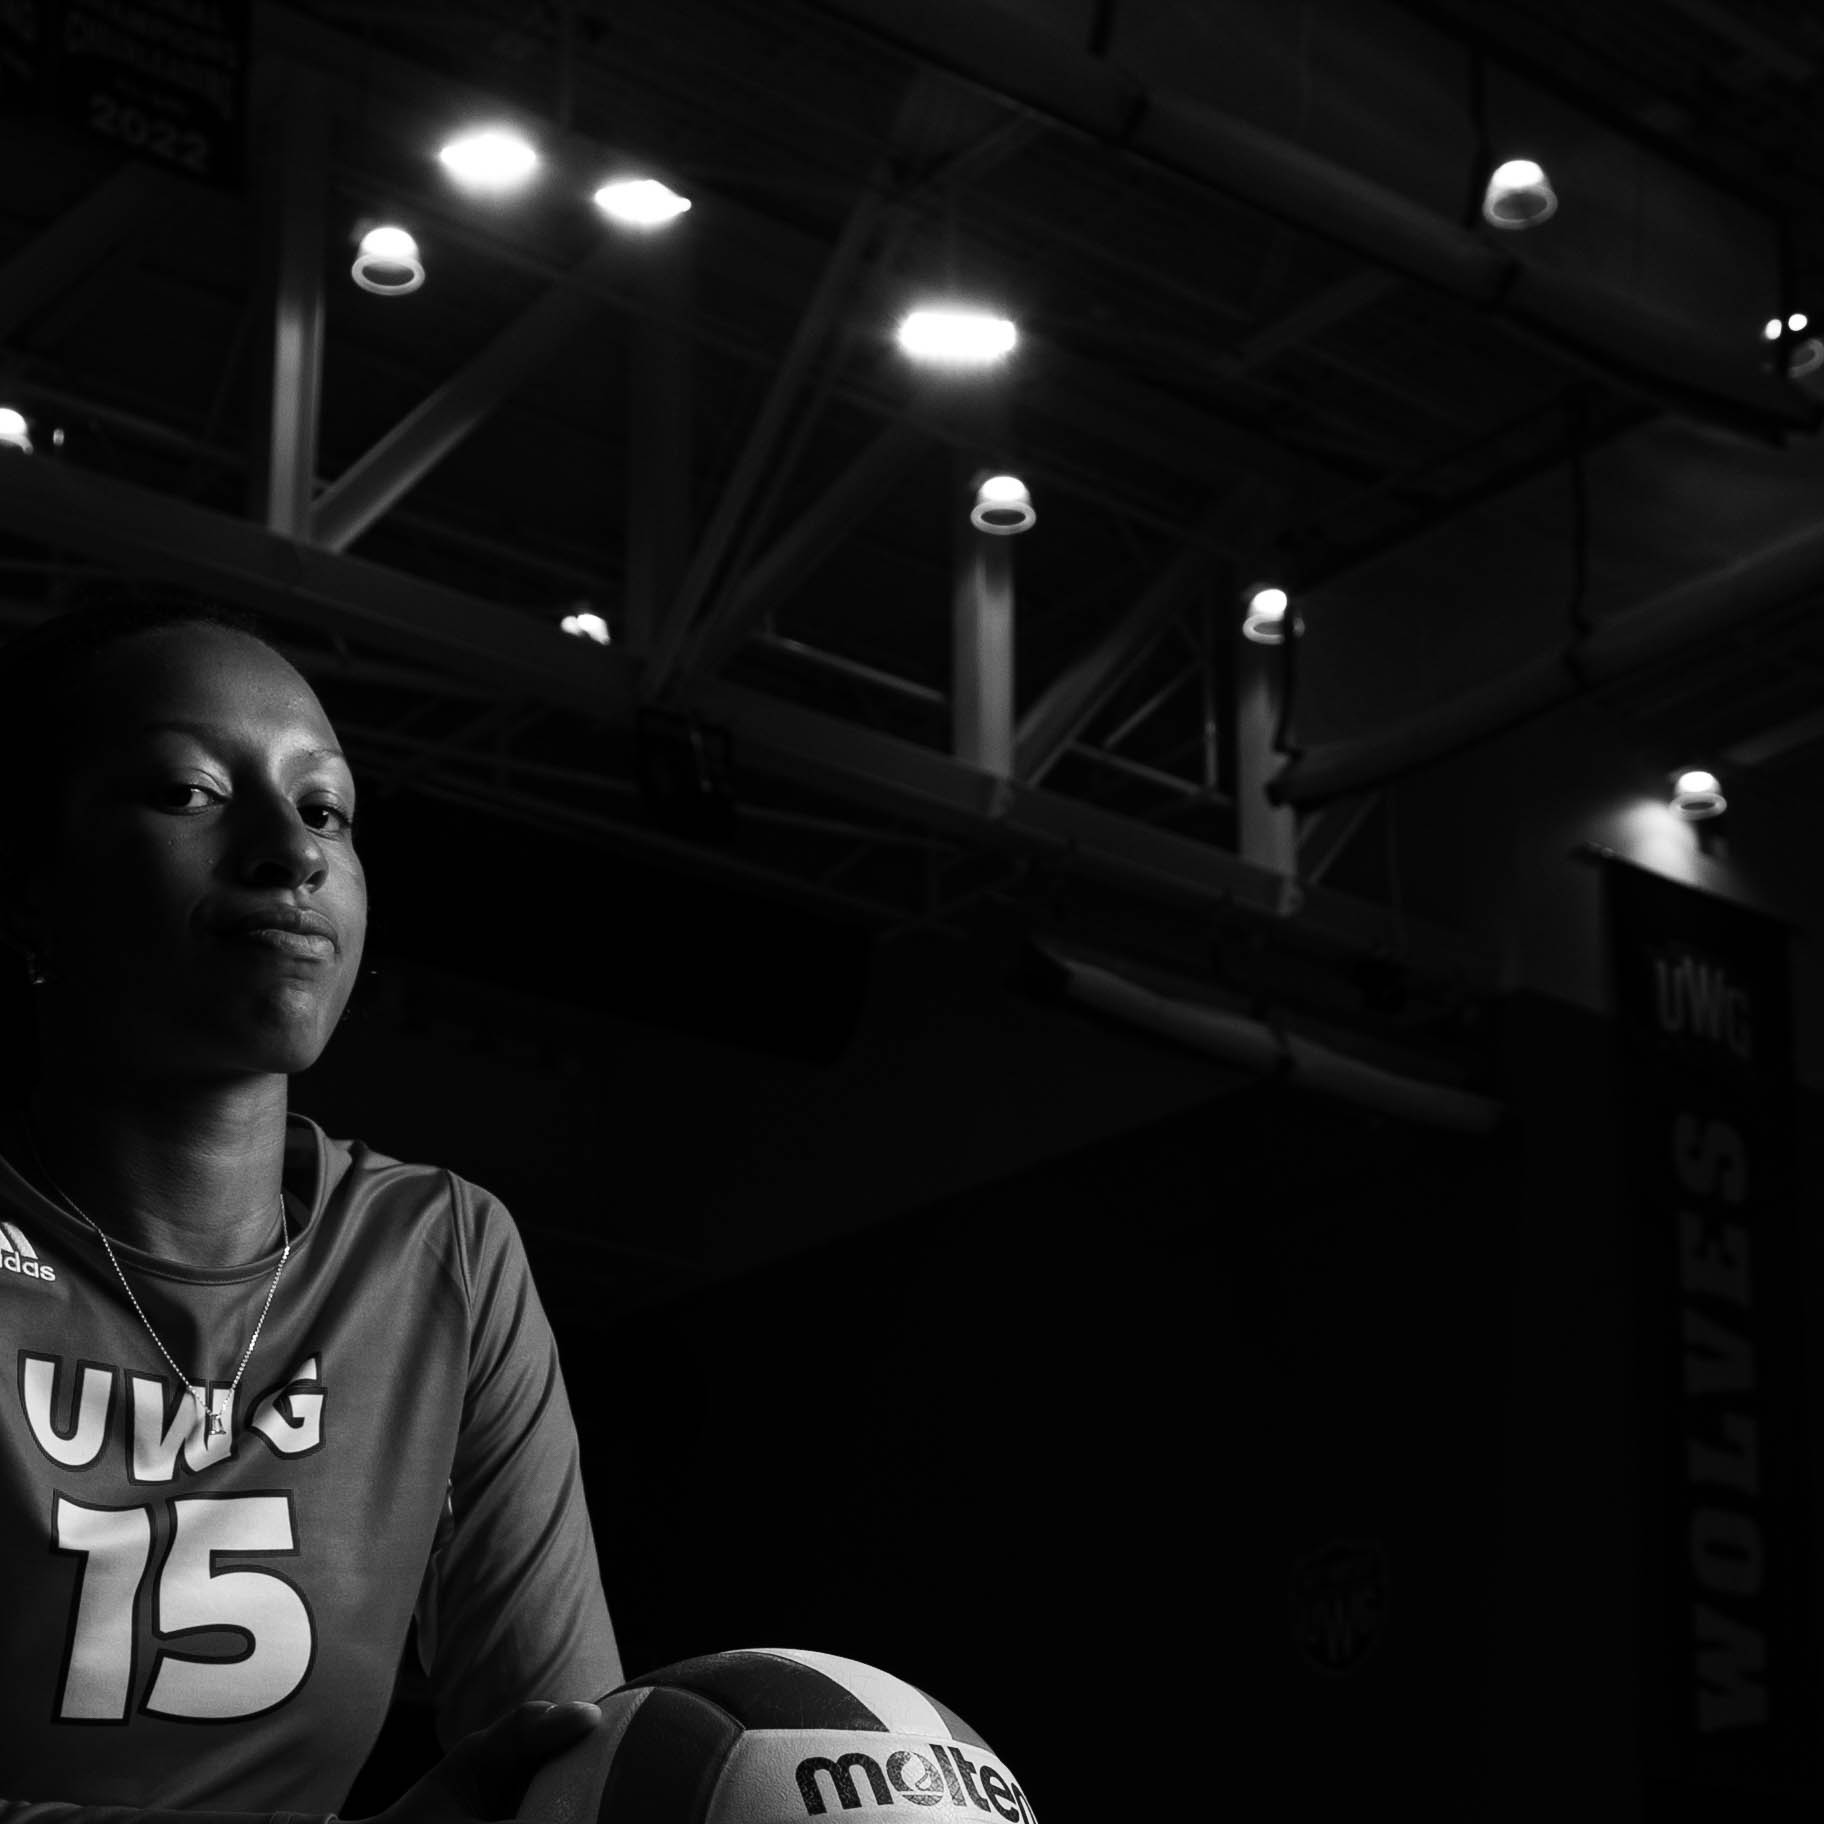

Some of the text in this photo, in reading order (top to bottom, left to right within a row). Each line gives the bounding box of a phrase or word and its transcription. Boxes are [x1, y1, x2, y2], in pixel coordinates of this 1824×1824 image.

[87, 91, 210, 174] 2022
[1652, 953, 1753, 1063] UWG
[18, 1350, 328, 1485] UWG
[1674, 1109, 1771, 1737] WOLVES
[49, 1490, 317, 1726] 15
